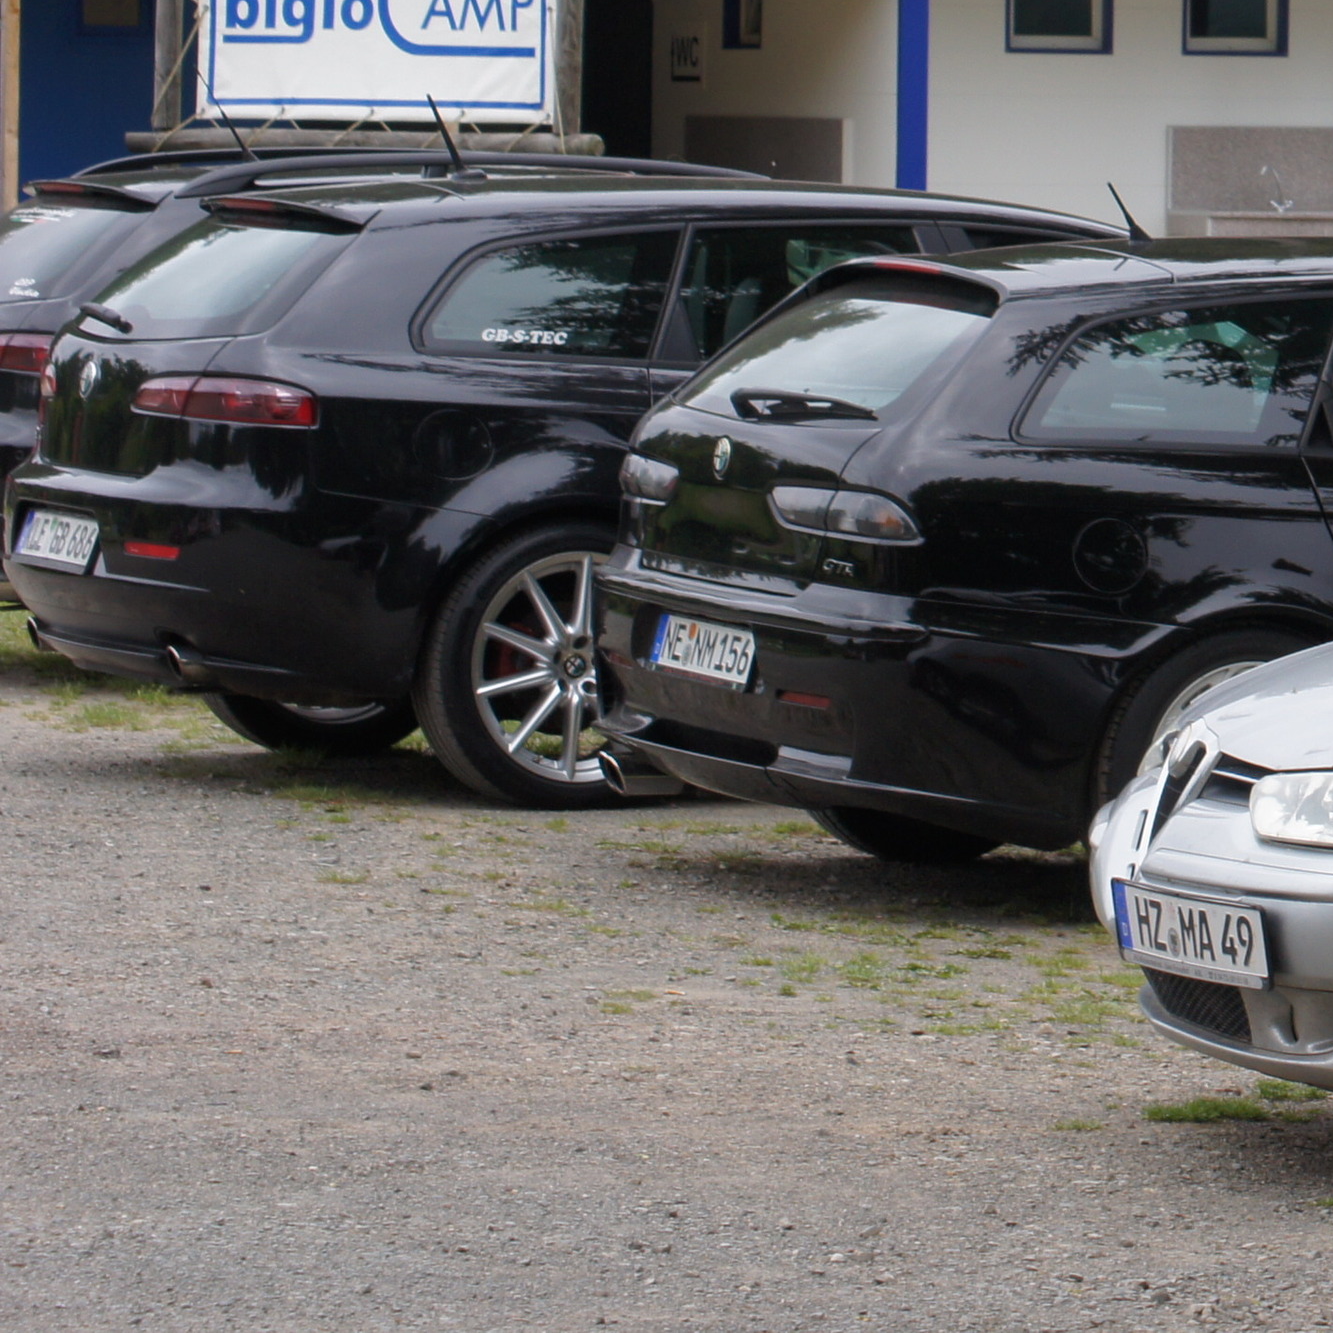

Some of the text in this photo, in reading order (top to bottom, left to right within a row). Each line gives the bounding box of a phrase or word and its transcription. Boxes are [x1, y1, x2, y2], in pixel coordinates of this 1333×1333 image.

[675, 36, 699, 67] WC
[481, 328, 568, 345] GB-S-TEC
[662, 620, 751, 676] NE NM 156
[1134, 895, 1254, 967] HZ MA 49
